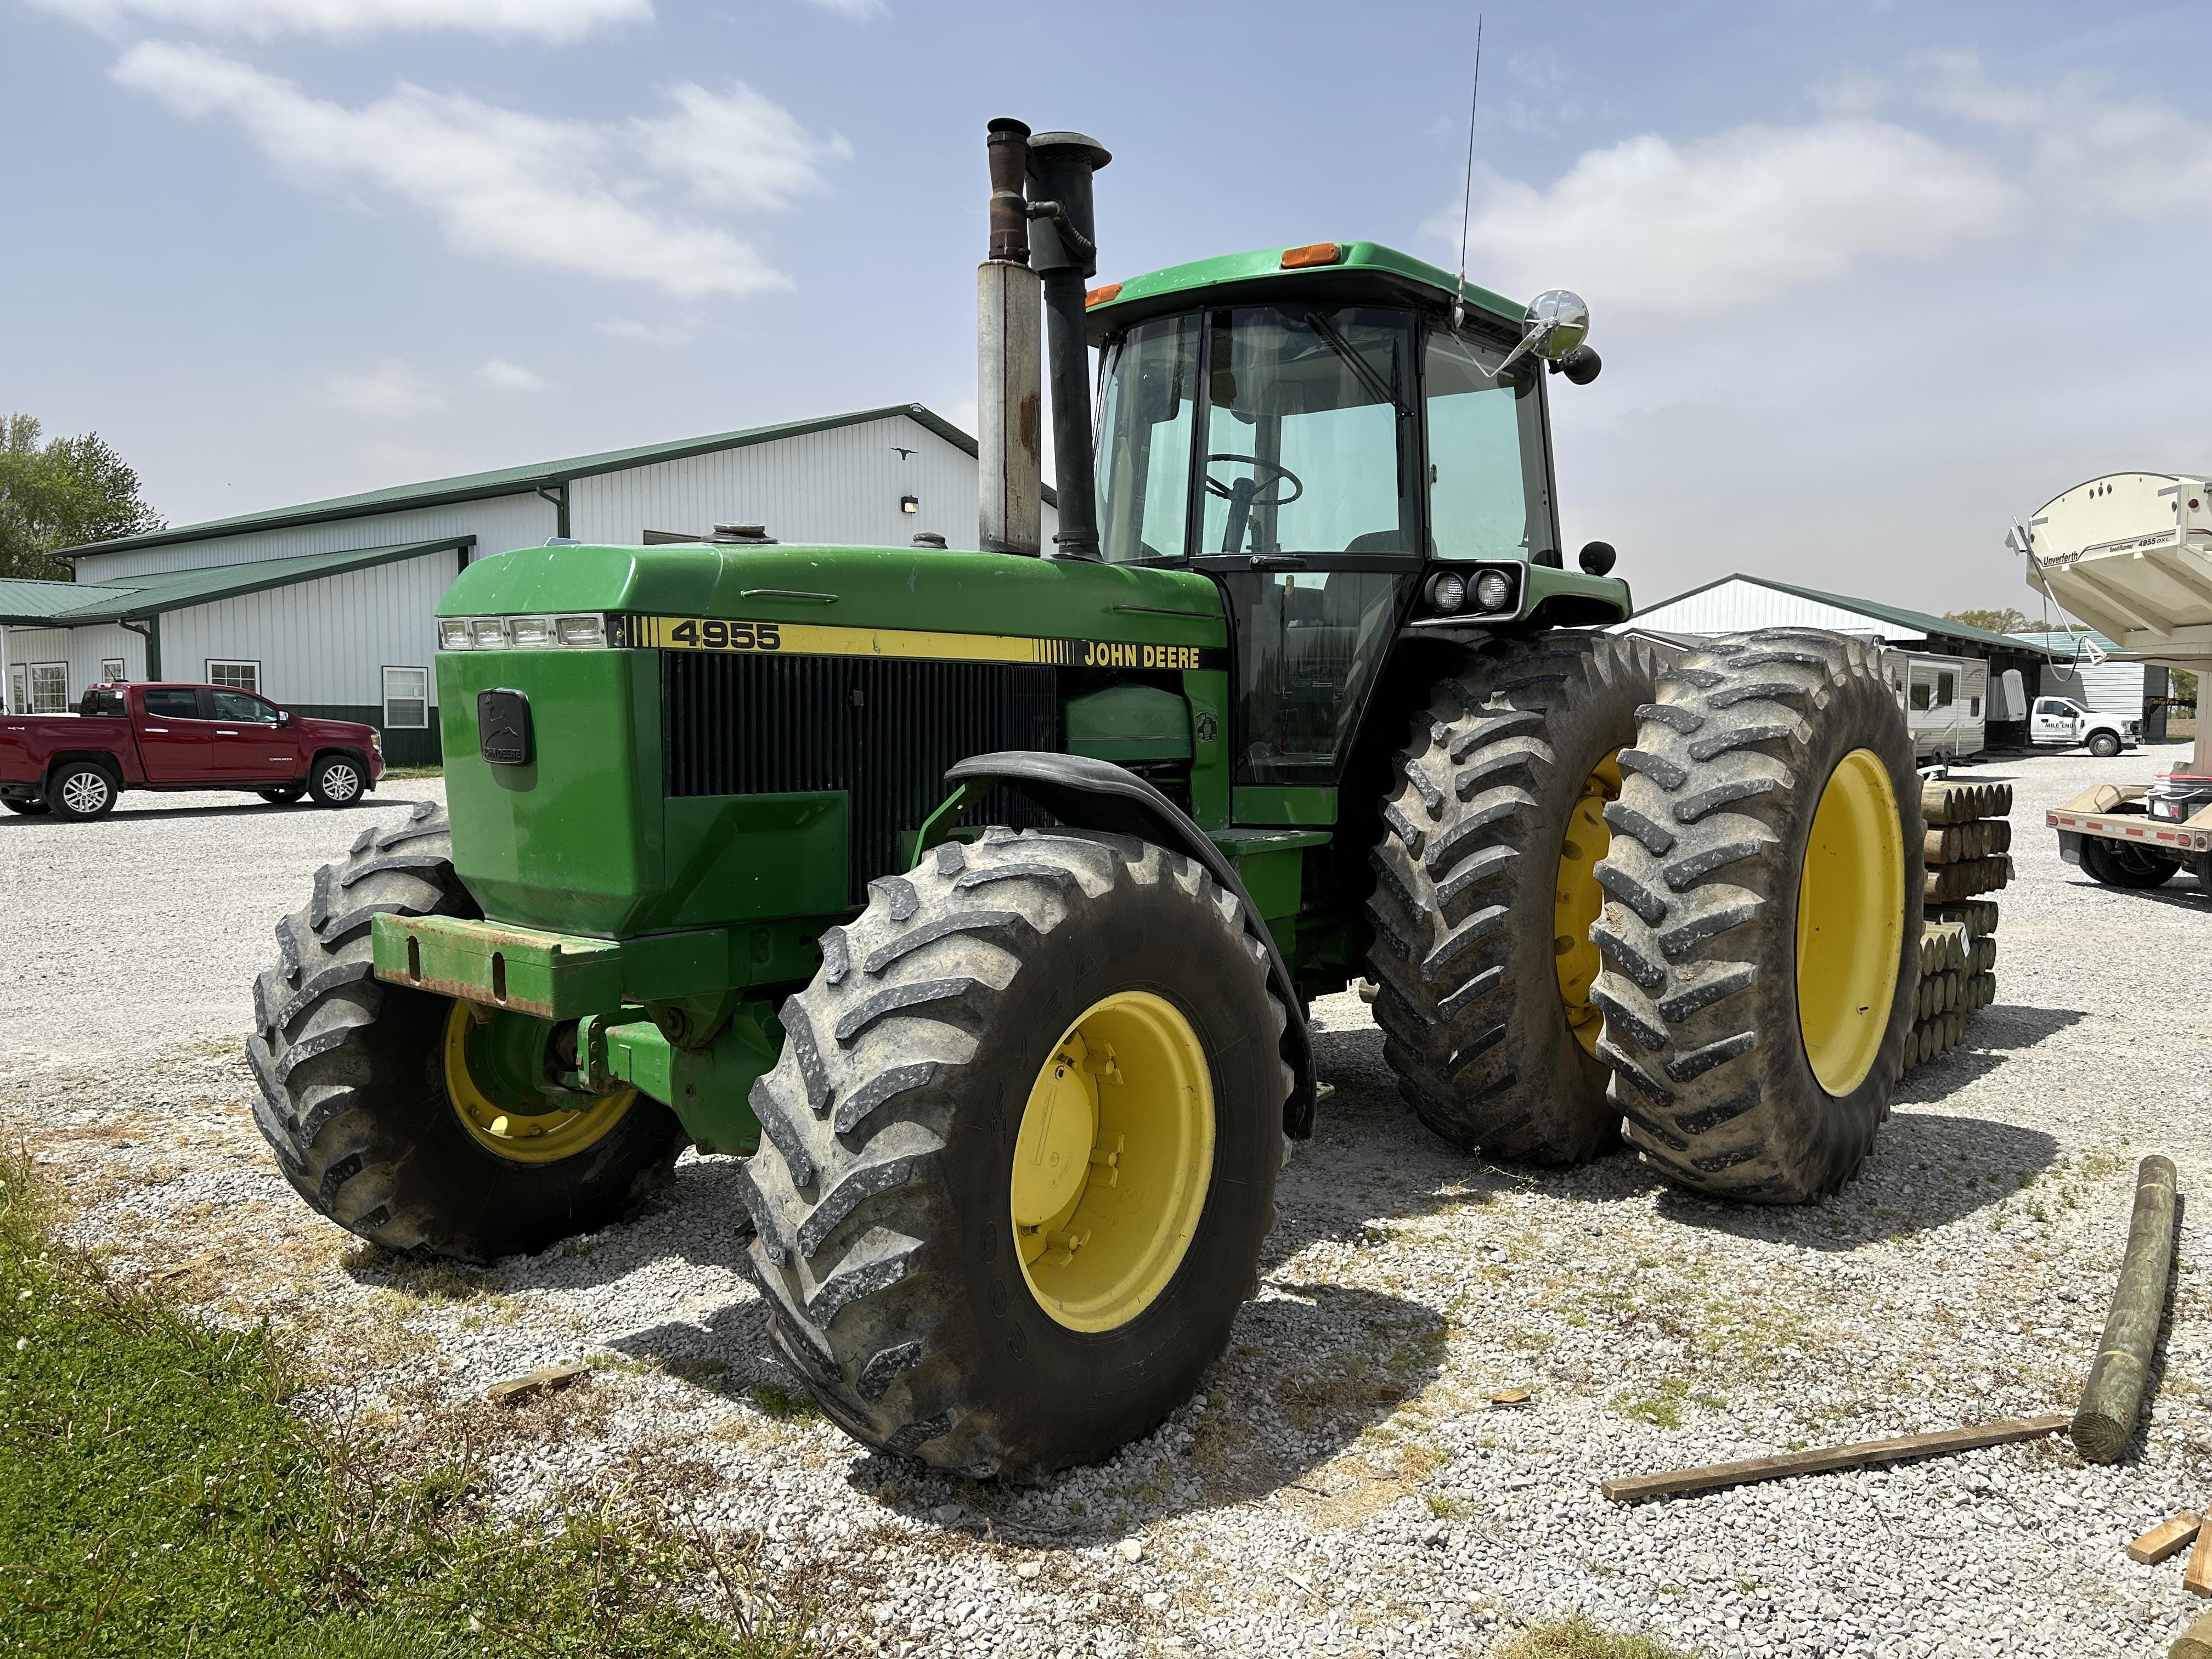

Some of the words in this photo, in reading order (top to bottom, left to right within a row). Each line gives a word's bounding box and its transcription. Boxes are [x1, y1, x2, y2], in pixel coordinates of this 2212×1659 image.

[2138, 538, 2156, 546] 4955
[2044, 551, 2078, 566] Unverferth
[672, 620, 781, 650] 4955
[1084, 640, 1137, 667] JOHN
[1143, 645, 1200, 669] DEERE
[498, 748, 522, 760] DEERE
